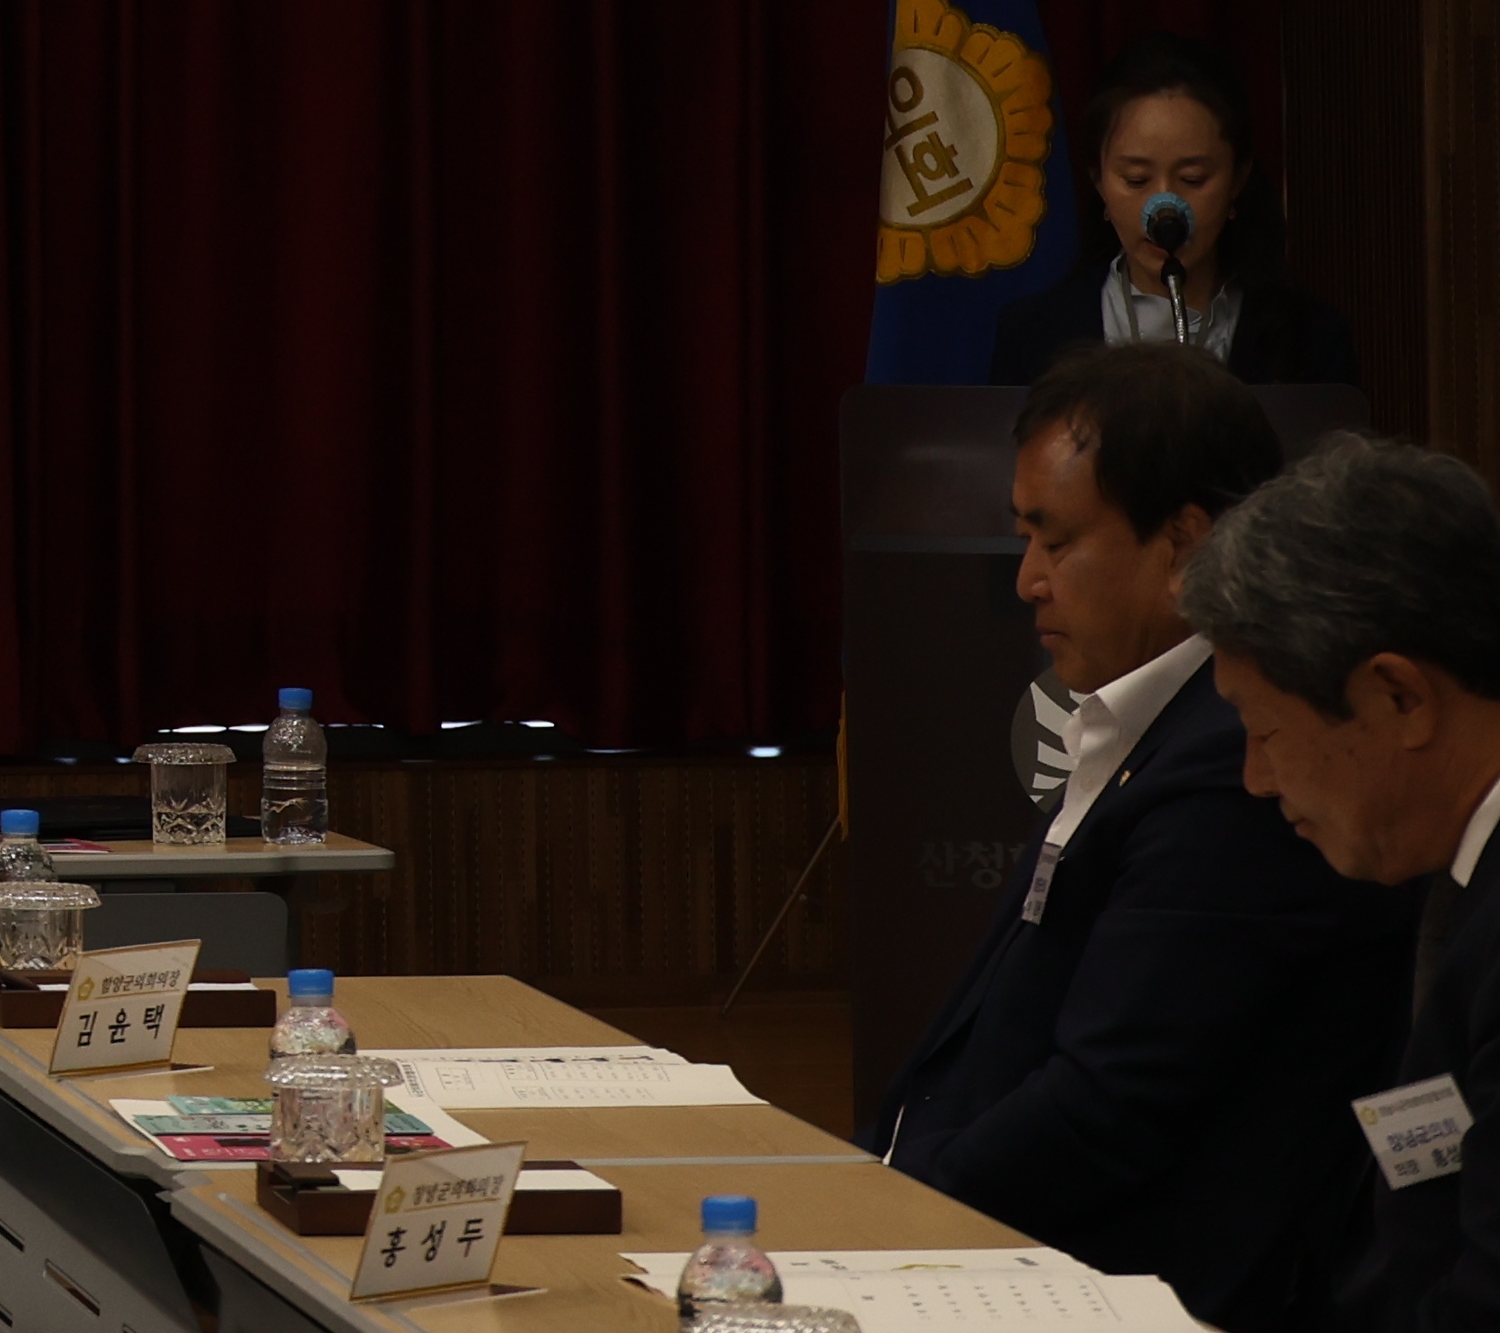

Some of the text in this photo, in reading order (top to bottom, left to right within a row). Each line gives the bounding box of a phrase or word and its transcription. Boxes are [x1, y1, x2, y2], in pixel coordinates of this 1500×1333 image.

[918, 840, 1031, 890] 산청
[102, 970, 181, 995] 함양군의회의장
[77, 1003, 166, 1048] 김윤택
[380, 1218, 485, 1268] 홍성두
